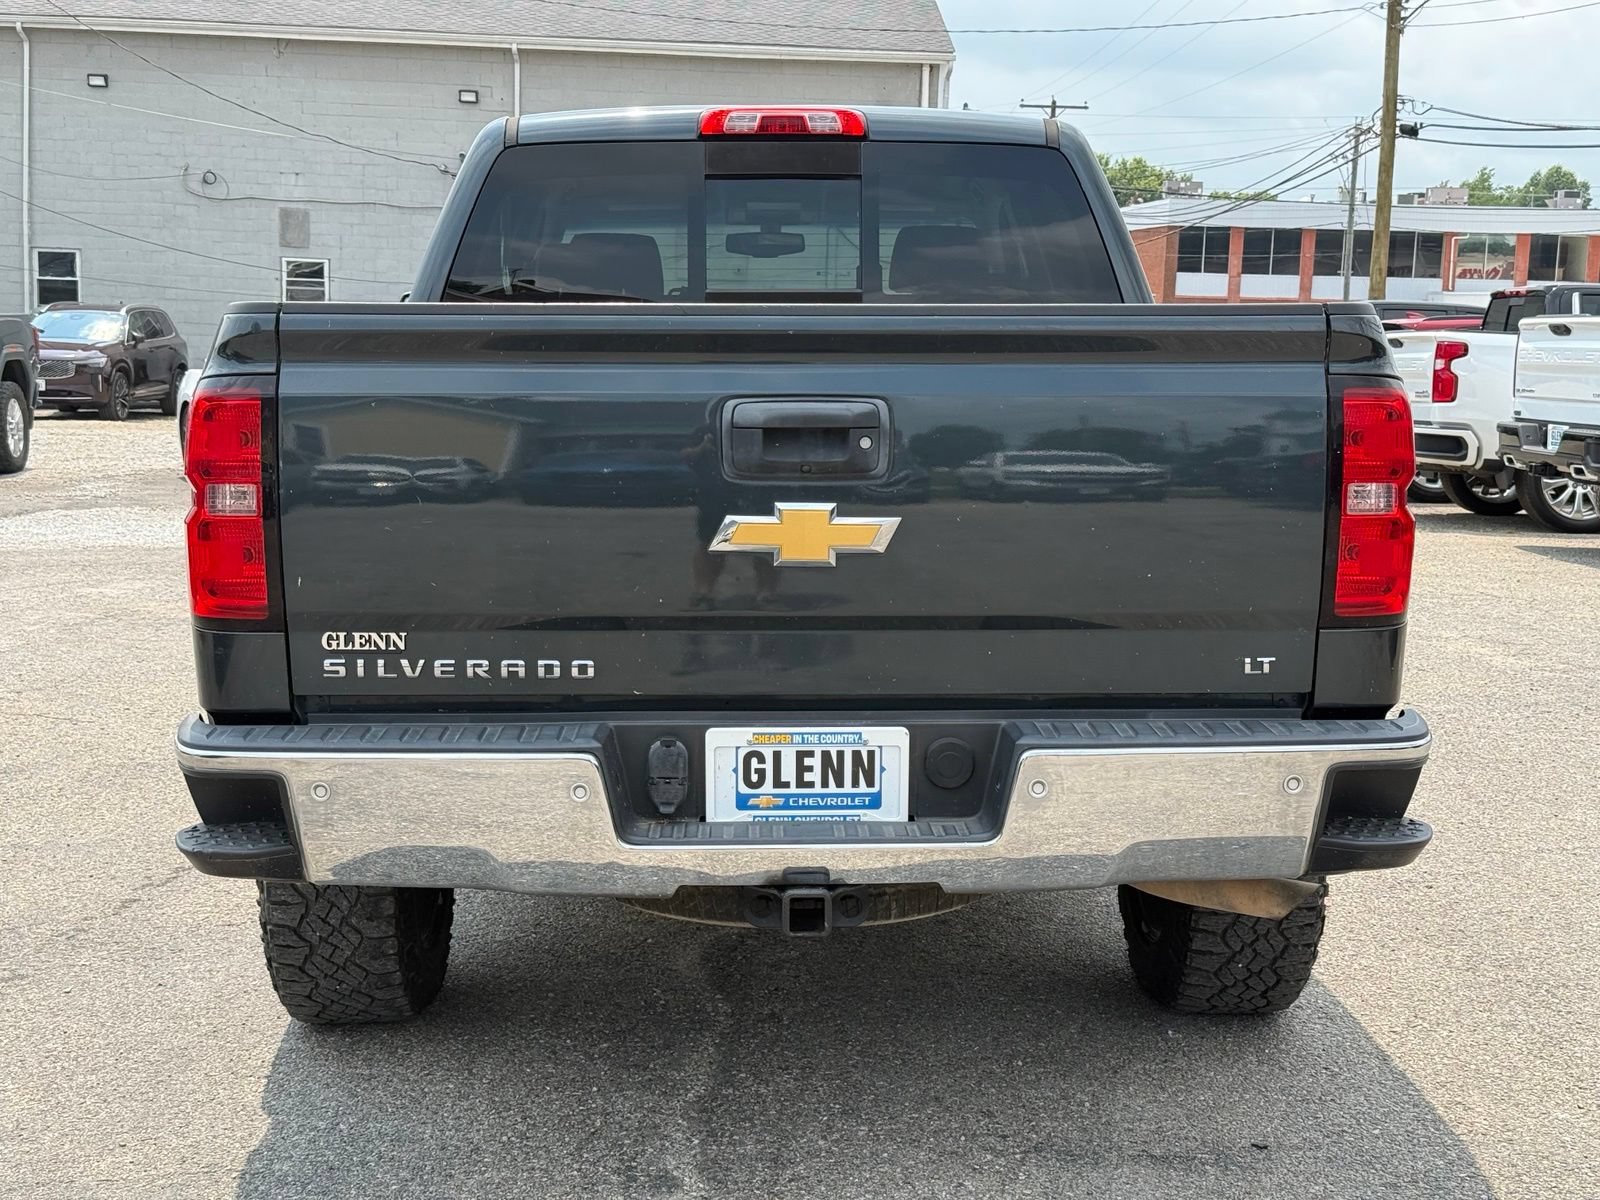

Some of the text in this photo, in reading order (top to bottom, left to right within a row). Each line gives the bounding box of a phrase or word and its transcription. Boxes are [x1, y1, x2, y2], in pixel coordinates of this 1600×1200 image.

[321, 631, 408, 651] GLENN
[322, 658, 595, 679] SILVERADO
[1244, 657, 1276, 674] LT
[753, 734, 792, 744] CHEAPER
[793, 734, 802, 744] IN
[803, 734, 820, 743] THE
[742, 749, 876, 790] GLENN
[789, 797, 872, 806] CHEVROLET
